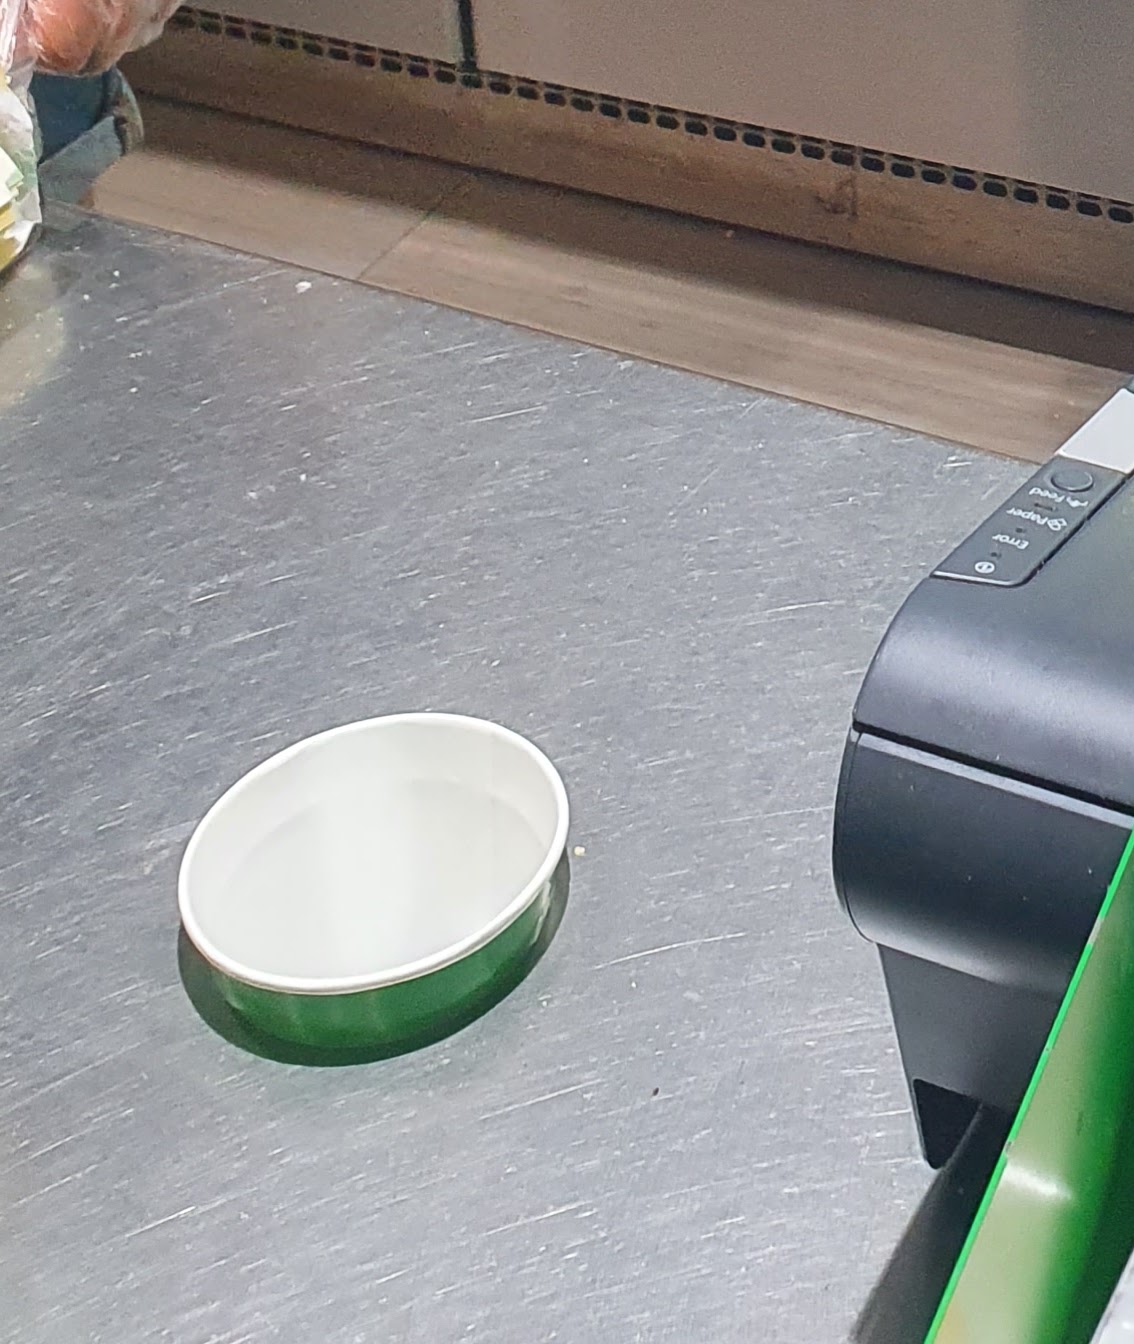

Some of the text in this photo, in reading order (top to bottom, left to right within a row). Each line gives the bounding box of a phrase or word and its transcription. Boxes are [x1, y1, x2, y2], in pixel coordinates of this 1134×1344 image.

[1029, 487, 1065, 503] Feed
[1006, 507, 1048, 525] Paper
[992, 534, 1029, 550] Error
